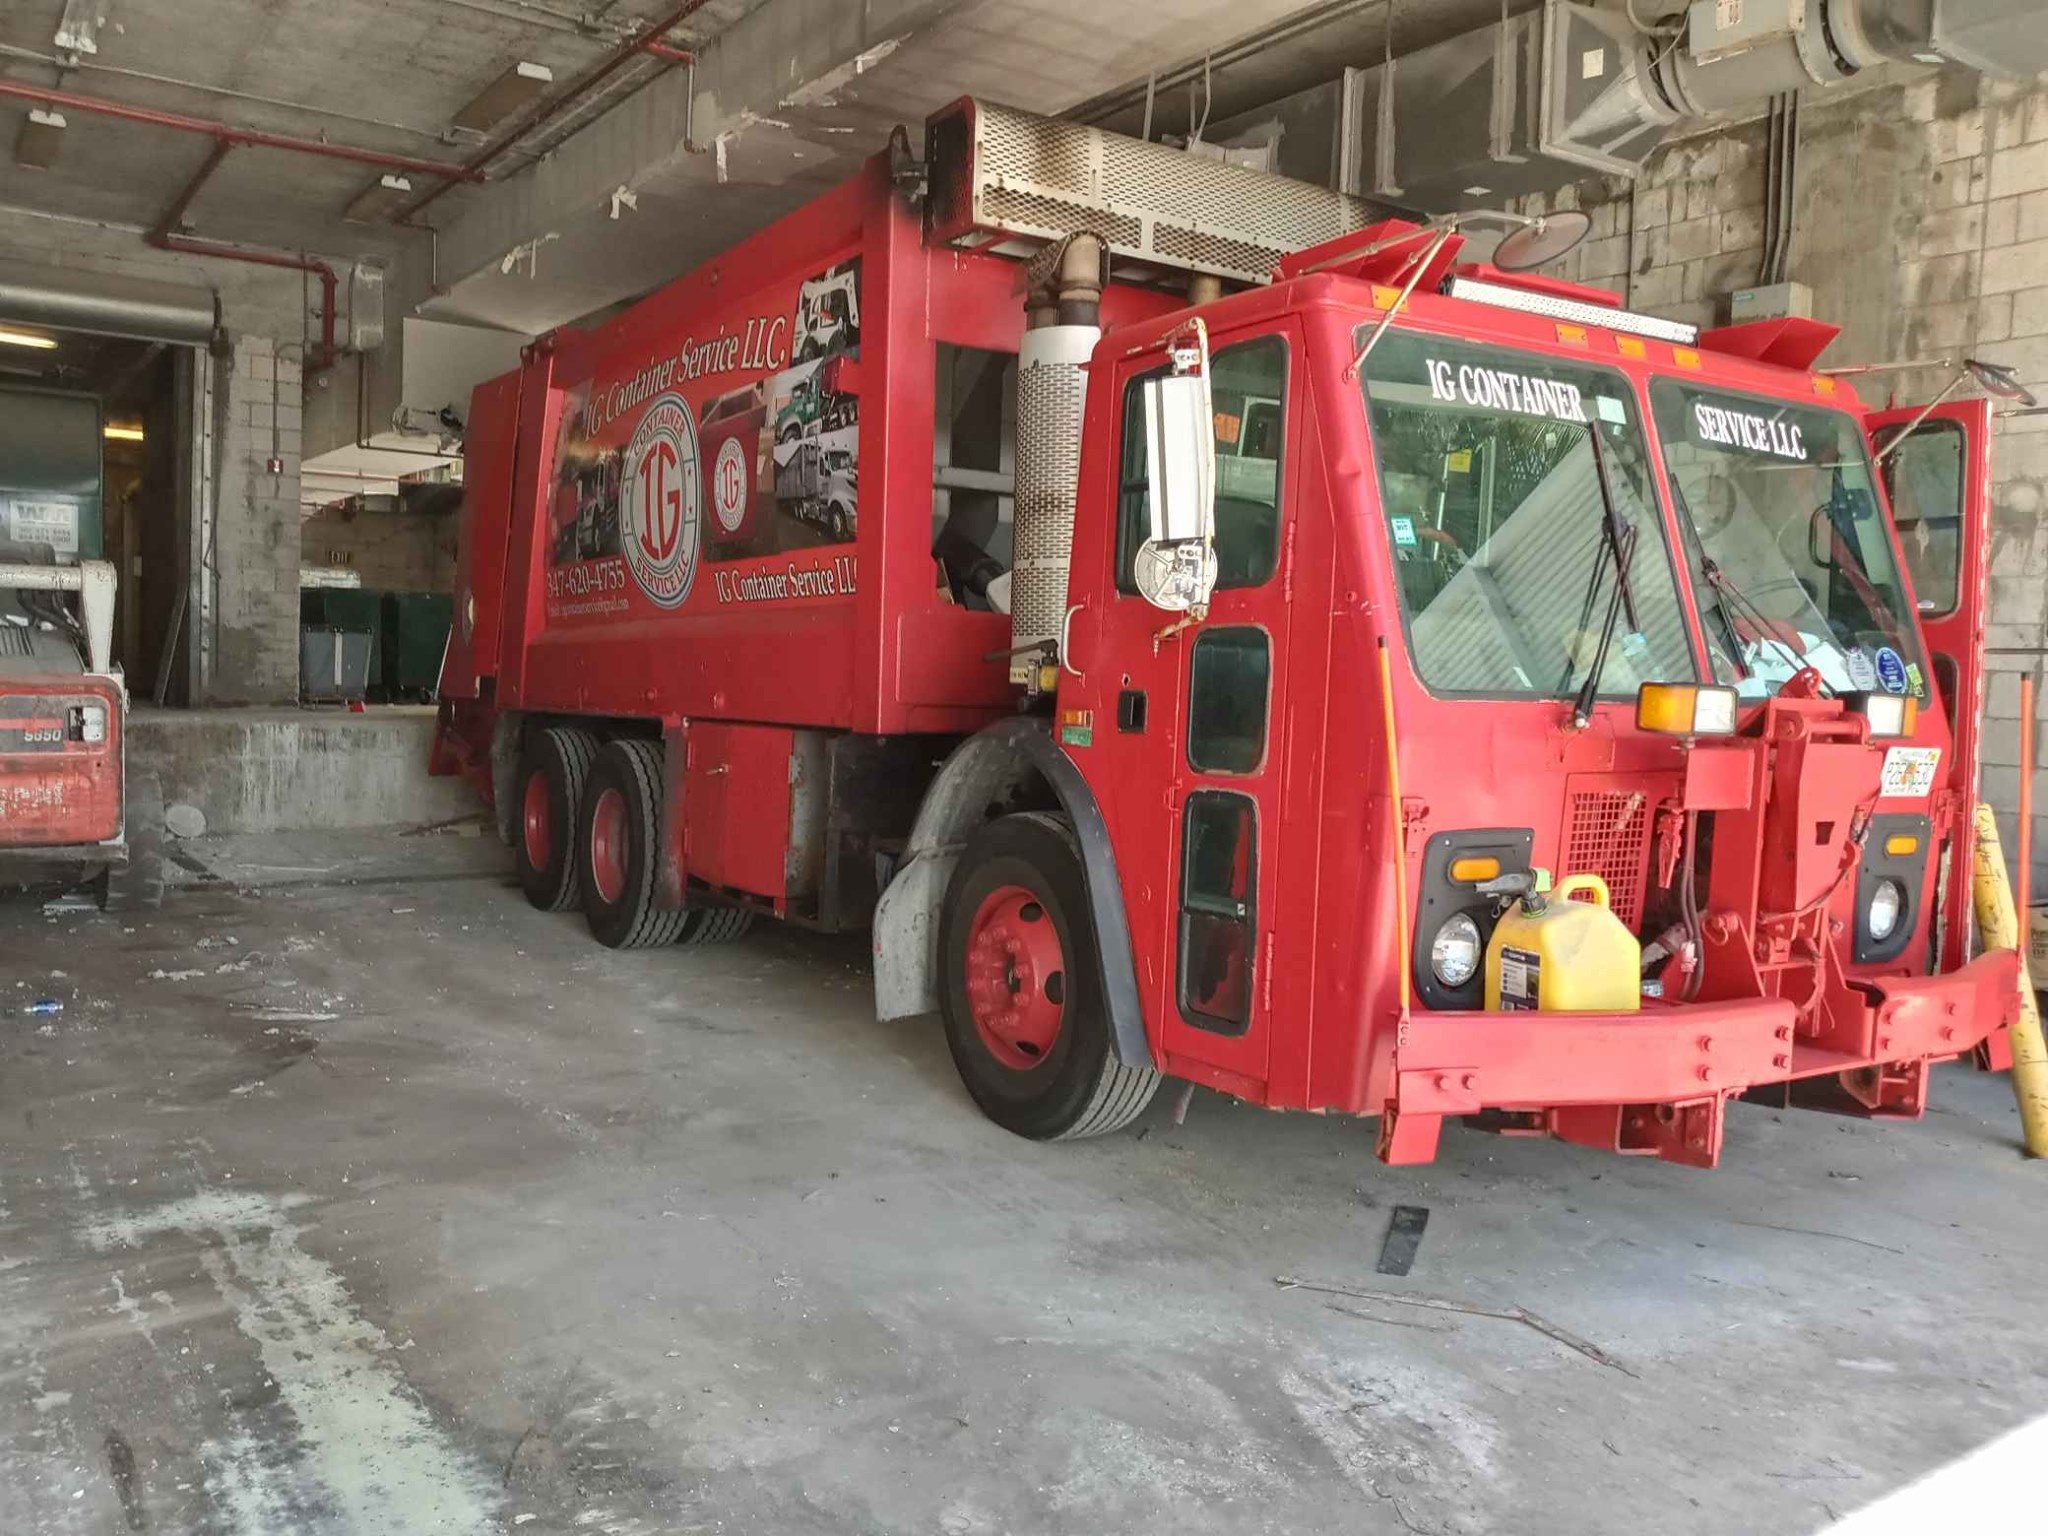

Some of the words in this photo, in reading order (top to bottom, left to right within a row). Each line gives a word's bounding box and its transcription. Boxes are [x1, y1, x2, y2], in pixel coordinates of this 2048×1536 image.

[584, 394, 605, 442] IG
[606, 356, 679, 424] Container
[677, 324, 739, 384] Service
[1425, 358, 1456, 401] IG
[1459, 364, 1587, 422] CONTAINER
[633, 405, 684, 456] CONTAINER
[1695, 402, 1770, 452] SERVICE
[1767, 420, 1807, 460] LLC
[639, 440, 680, 560] IG
[633, 556, 677, 595] SERVICE
[674, 549, 690, 585] LLC
[714, 571, 732, 603] IG
[731, 564, 789, 602] Container
[788, 559, 835, 598] Service
[834, 556, 858, 594] LL
